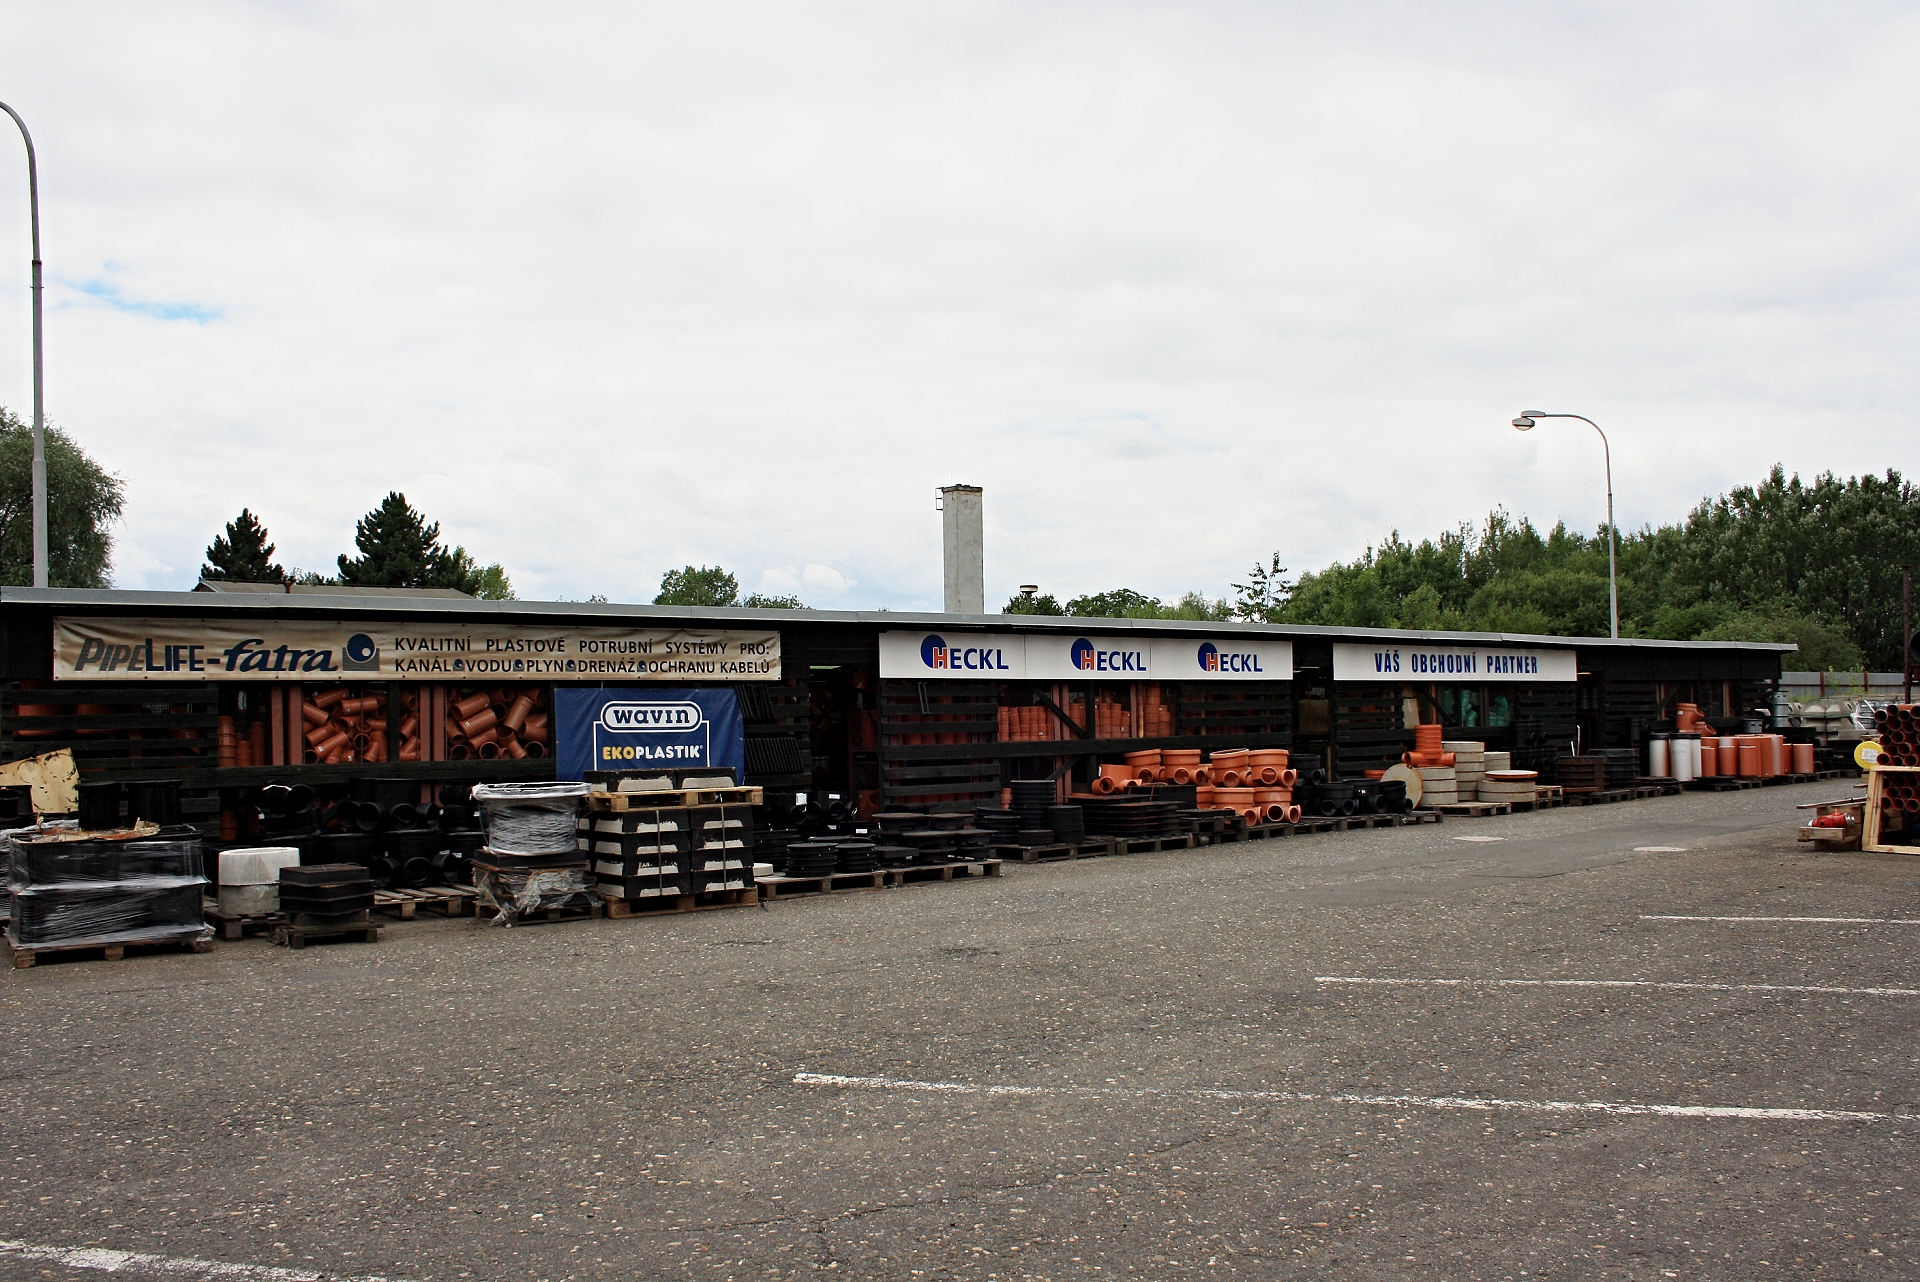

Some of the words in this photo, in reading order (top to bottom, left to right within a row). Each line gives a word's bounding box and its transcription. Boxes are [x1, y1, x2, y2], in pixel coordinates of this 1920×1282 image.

[395, 636, 471, 651] KVALITNÍ
[486, 637, 566, 653] PLASTOVÉ
[579, 639, 653, 654] POTRUBNÍ
[665, 640, 728, 655] SYSTÉMY
[740, 643, 770, 655] PRO:
[395, 656, 452, 672] KANÁL
[466, 659, 512, 672] VODU
[526, 659, 564, 672] PLYN
[578, 658, 636, 673] DRENÁŽ
[648, 660, 715, 674] OCHRANU
[720, 659, 770, 674] KABELŮ
[933, 647, 1009, 670] HECKL
[1081, 650, 1147, 671] HECKL
[1206, 653, 1263, 672] HECKL
[1374, 649, 1400, 673] VÁŠ
[1411, 652, 1477, 674] OBCHODNÍ
[1486, 655, 1538, 674] PARTNER
[613, 709, 690, 724] wavin
